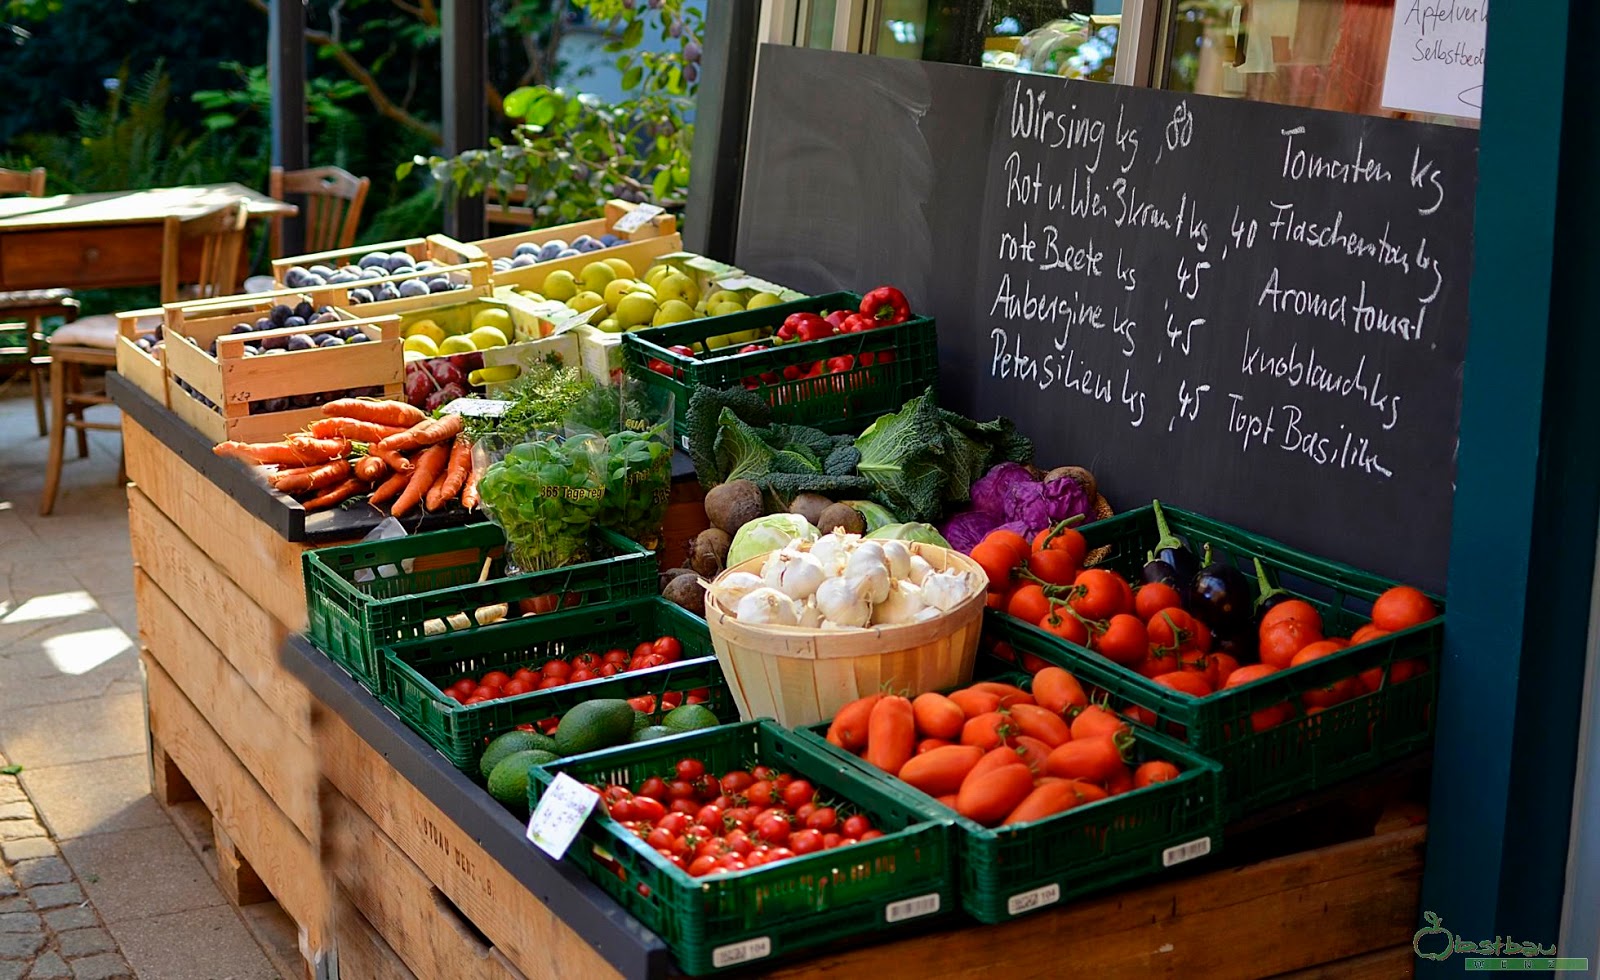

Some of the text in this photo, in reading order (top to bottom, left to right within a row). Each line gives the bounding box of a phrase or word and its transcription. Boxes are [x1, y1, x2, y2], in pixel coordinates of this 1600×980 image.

[1011, 79, 1105, 174] Wirsing
[1116, 103, 1139, 173] kg
[1281, 126, 1392, 184] Tomaten
[1004, 151, 1043, 208] Rot
[999, 221, 1037, 262] rote
[1039, 225, 1105, 277] Beete
[1117, 248, 1137, 290] kg
[989, 273, 1105, 351] Aubergine
[1113, 307, 1137, 357] kg
[1121, 369, 1146, 428] kg
[541, 486, 559, 498] 365
[563, 486, 585, 500] Tage
